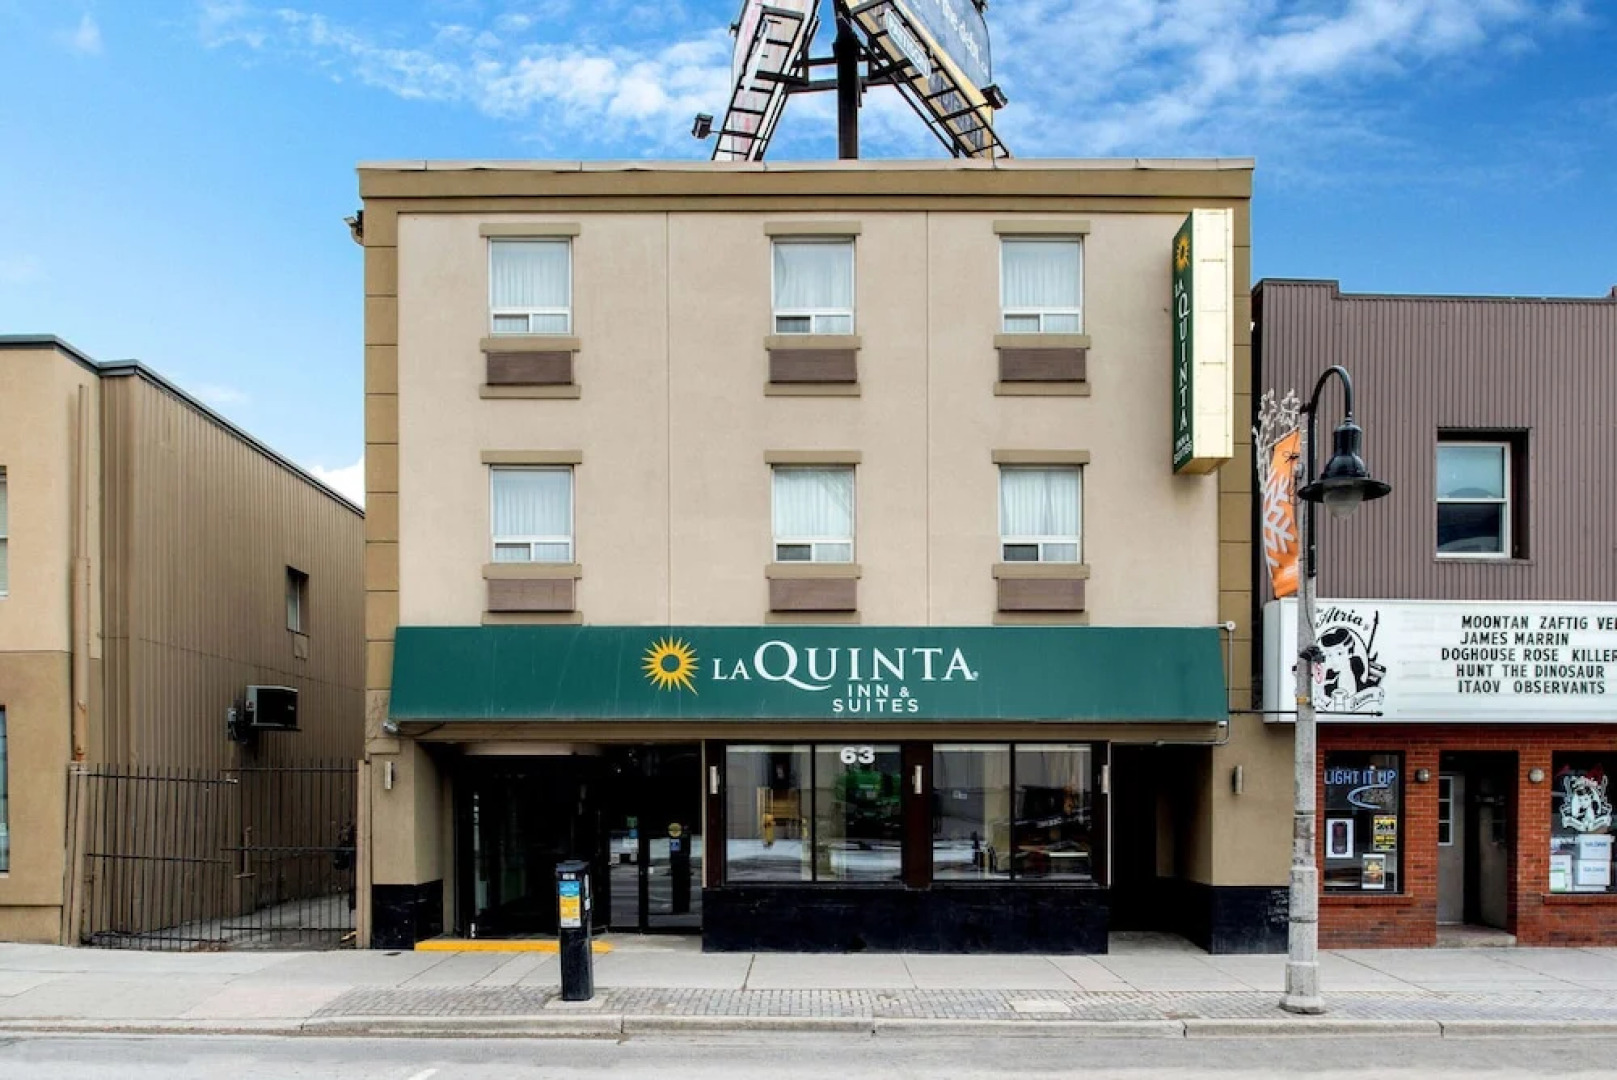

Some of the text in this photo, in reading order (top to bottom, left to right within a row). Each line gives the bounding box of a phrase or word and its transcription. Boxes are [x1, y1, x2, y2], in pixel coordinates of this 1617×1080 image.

[1178, 292, 1190, 431] QUINTA
[1461, 615, 1529, 630] MOONTAN
[1539, 615, 1588, 630] ZAFTIG
[1460, 631, 1569, 646] JAMES MARRIN
[1441, 647, 1516, 662] DOGHOUSE
[1523, 647, 1559, 662] ROSE
[712, 640, 977, 691] LA QUINTA
[1456, 663, 1605, 679] HUNT THE DINOSAUR
[848, 684, 910, 698] INN &
[1458, 680, 1605, 695] ITAOV OBSERVANTS
[832, 698, 919, 713] SUITES
[840, 746, 875, 764] 63
[1324, 769, 1397, 785] LIGHT IT UP
